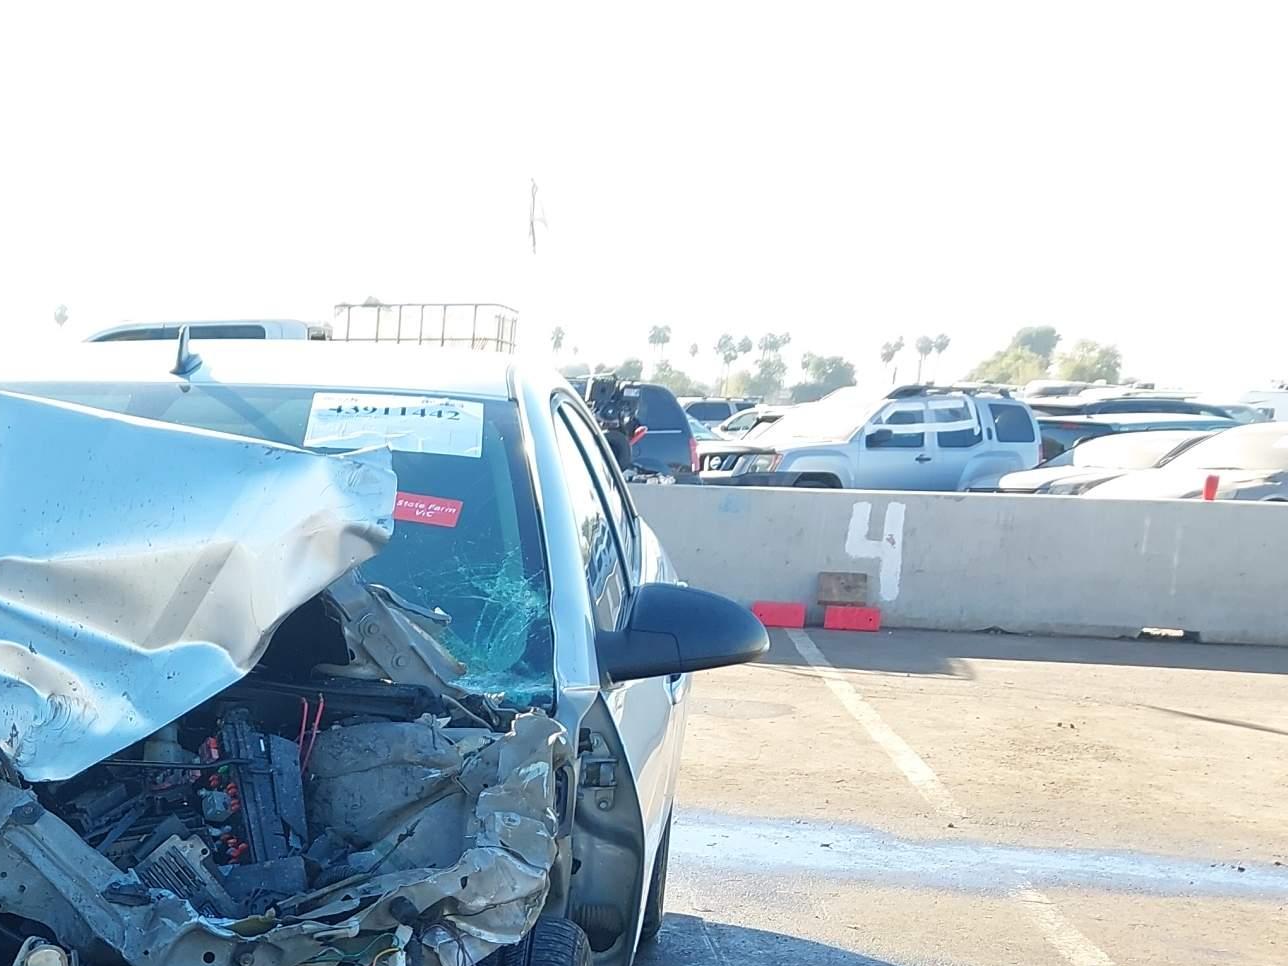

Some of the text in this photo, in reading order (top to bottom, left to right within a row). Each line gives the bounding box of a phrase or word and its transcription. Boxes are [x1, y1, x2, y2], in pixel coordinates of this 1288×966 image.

[328, 405, 460, 421] 43911442
[396, 499, 457, 513] State Farm
[845, 502, 906, 601] 4
